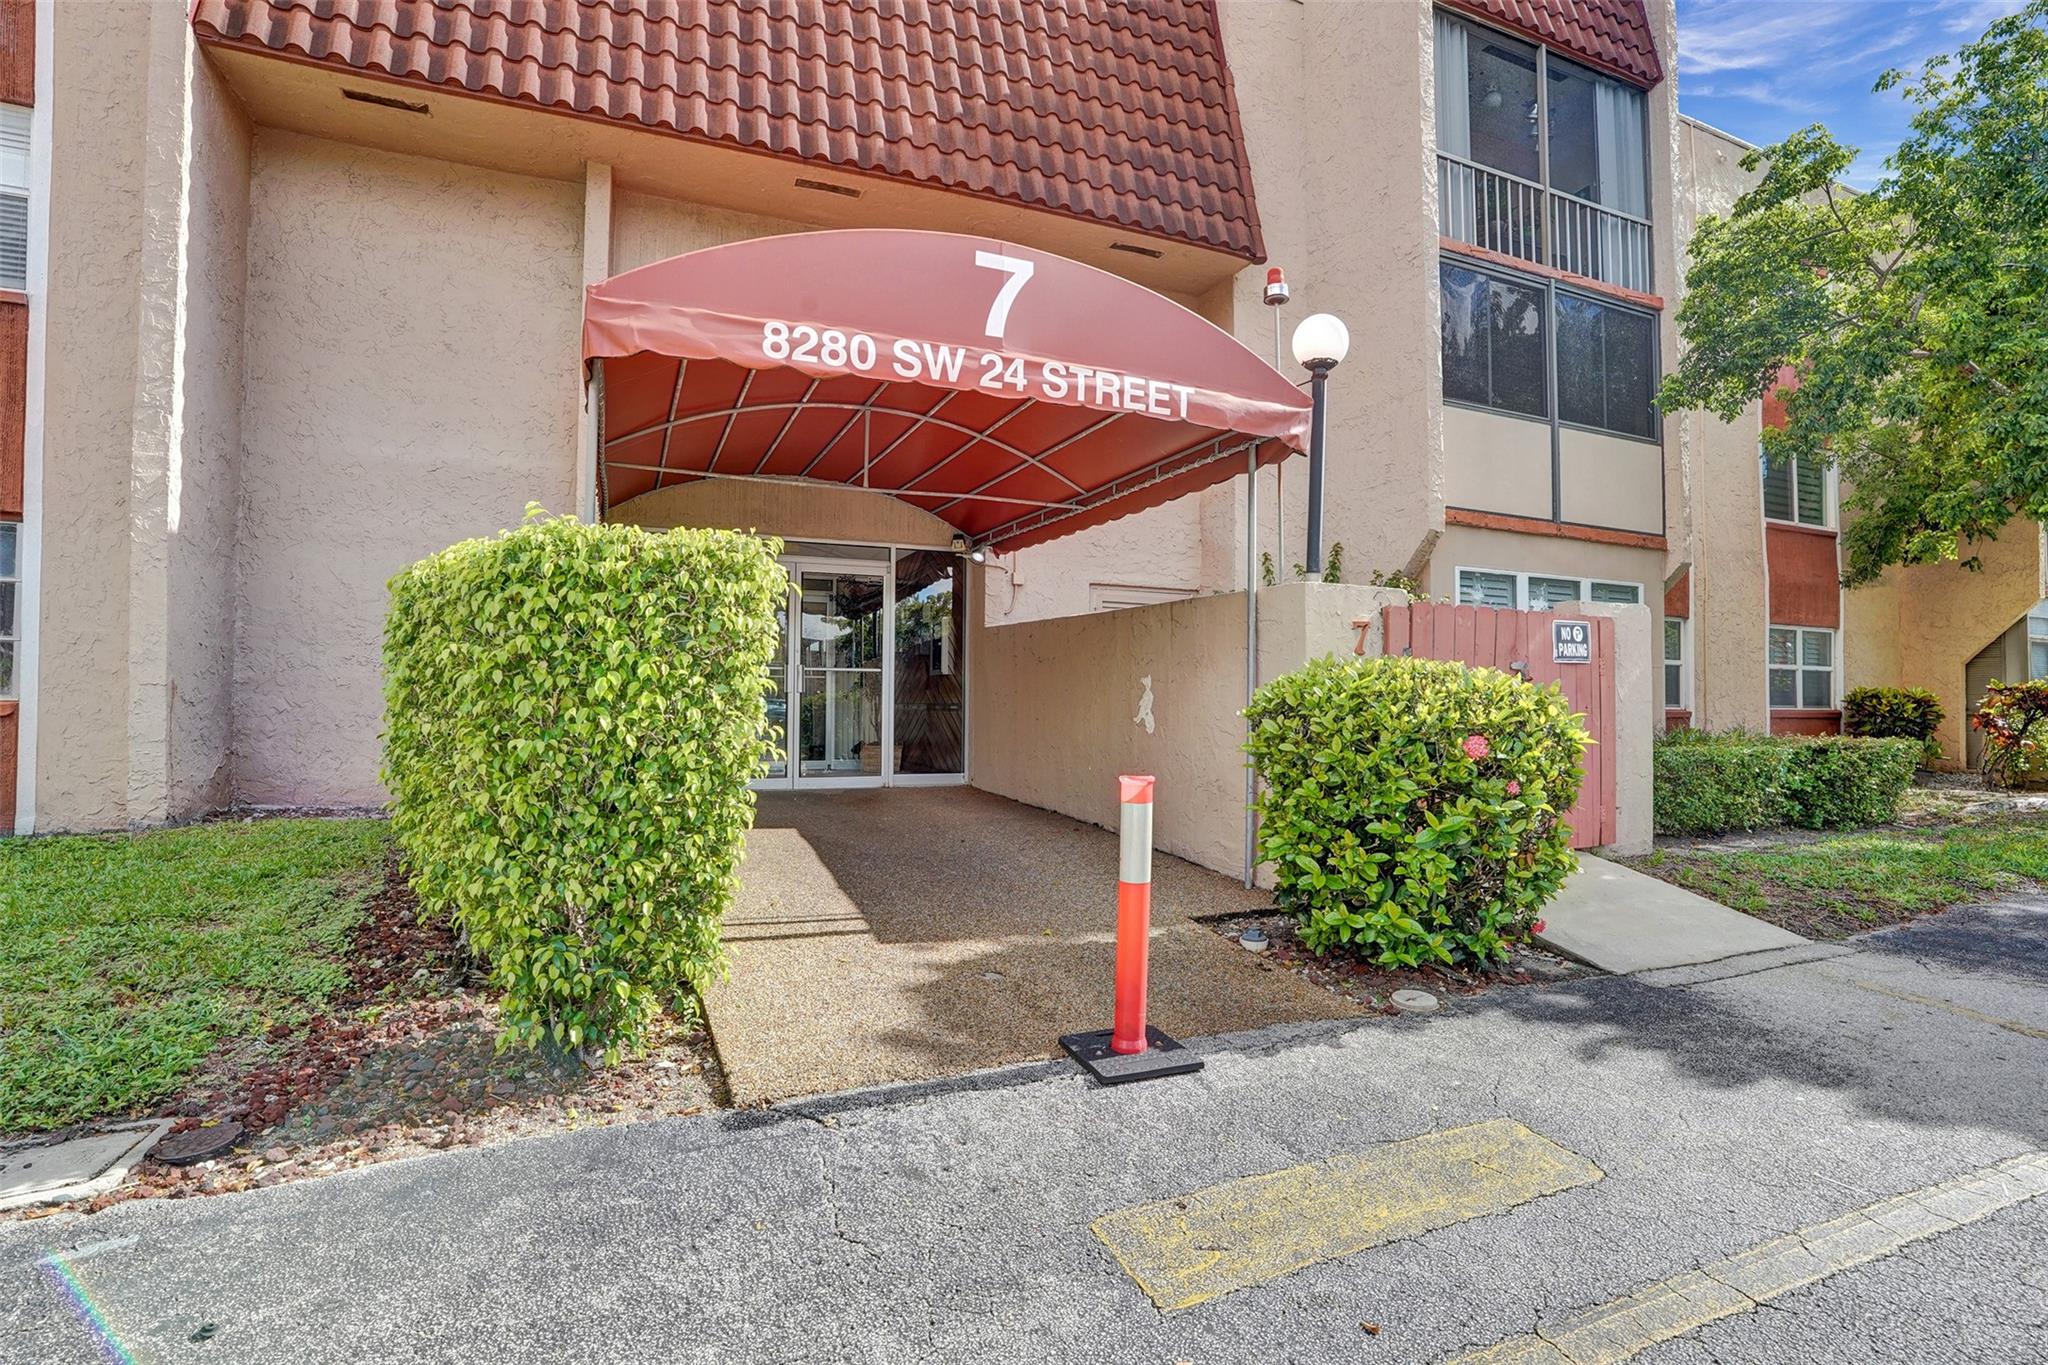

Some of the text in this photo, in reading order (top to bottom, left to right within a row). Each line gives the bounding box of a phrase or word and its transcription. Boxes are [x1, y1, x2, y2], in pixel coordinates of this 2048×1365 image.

[975, 250, 1034, 338] 7
[761, 321, 1196, 418] 8280 SW 24 STREET
[1352, 618, 1371, 656] 7
[1558, 643, 1588, 657] PARKING
[1560, 626, 1571, 641] NO
